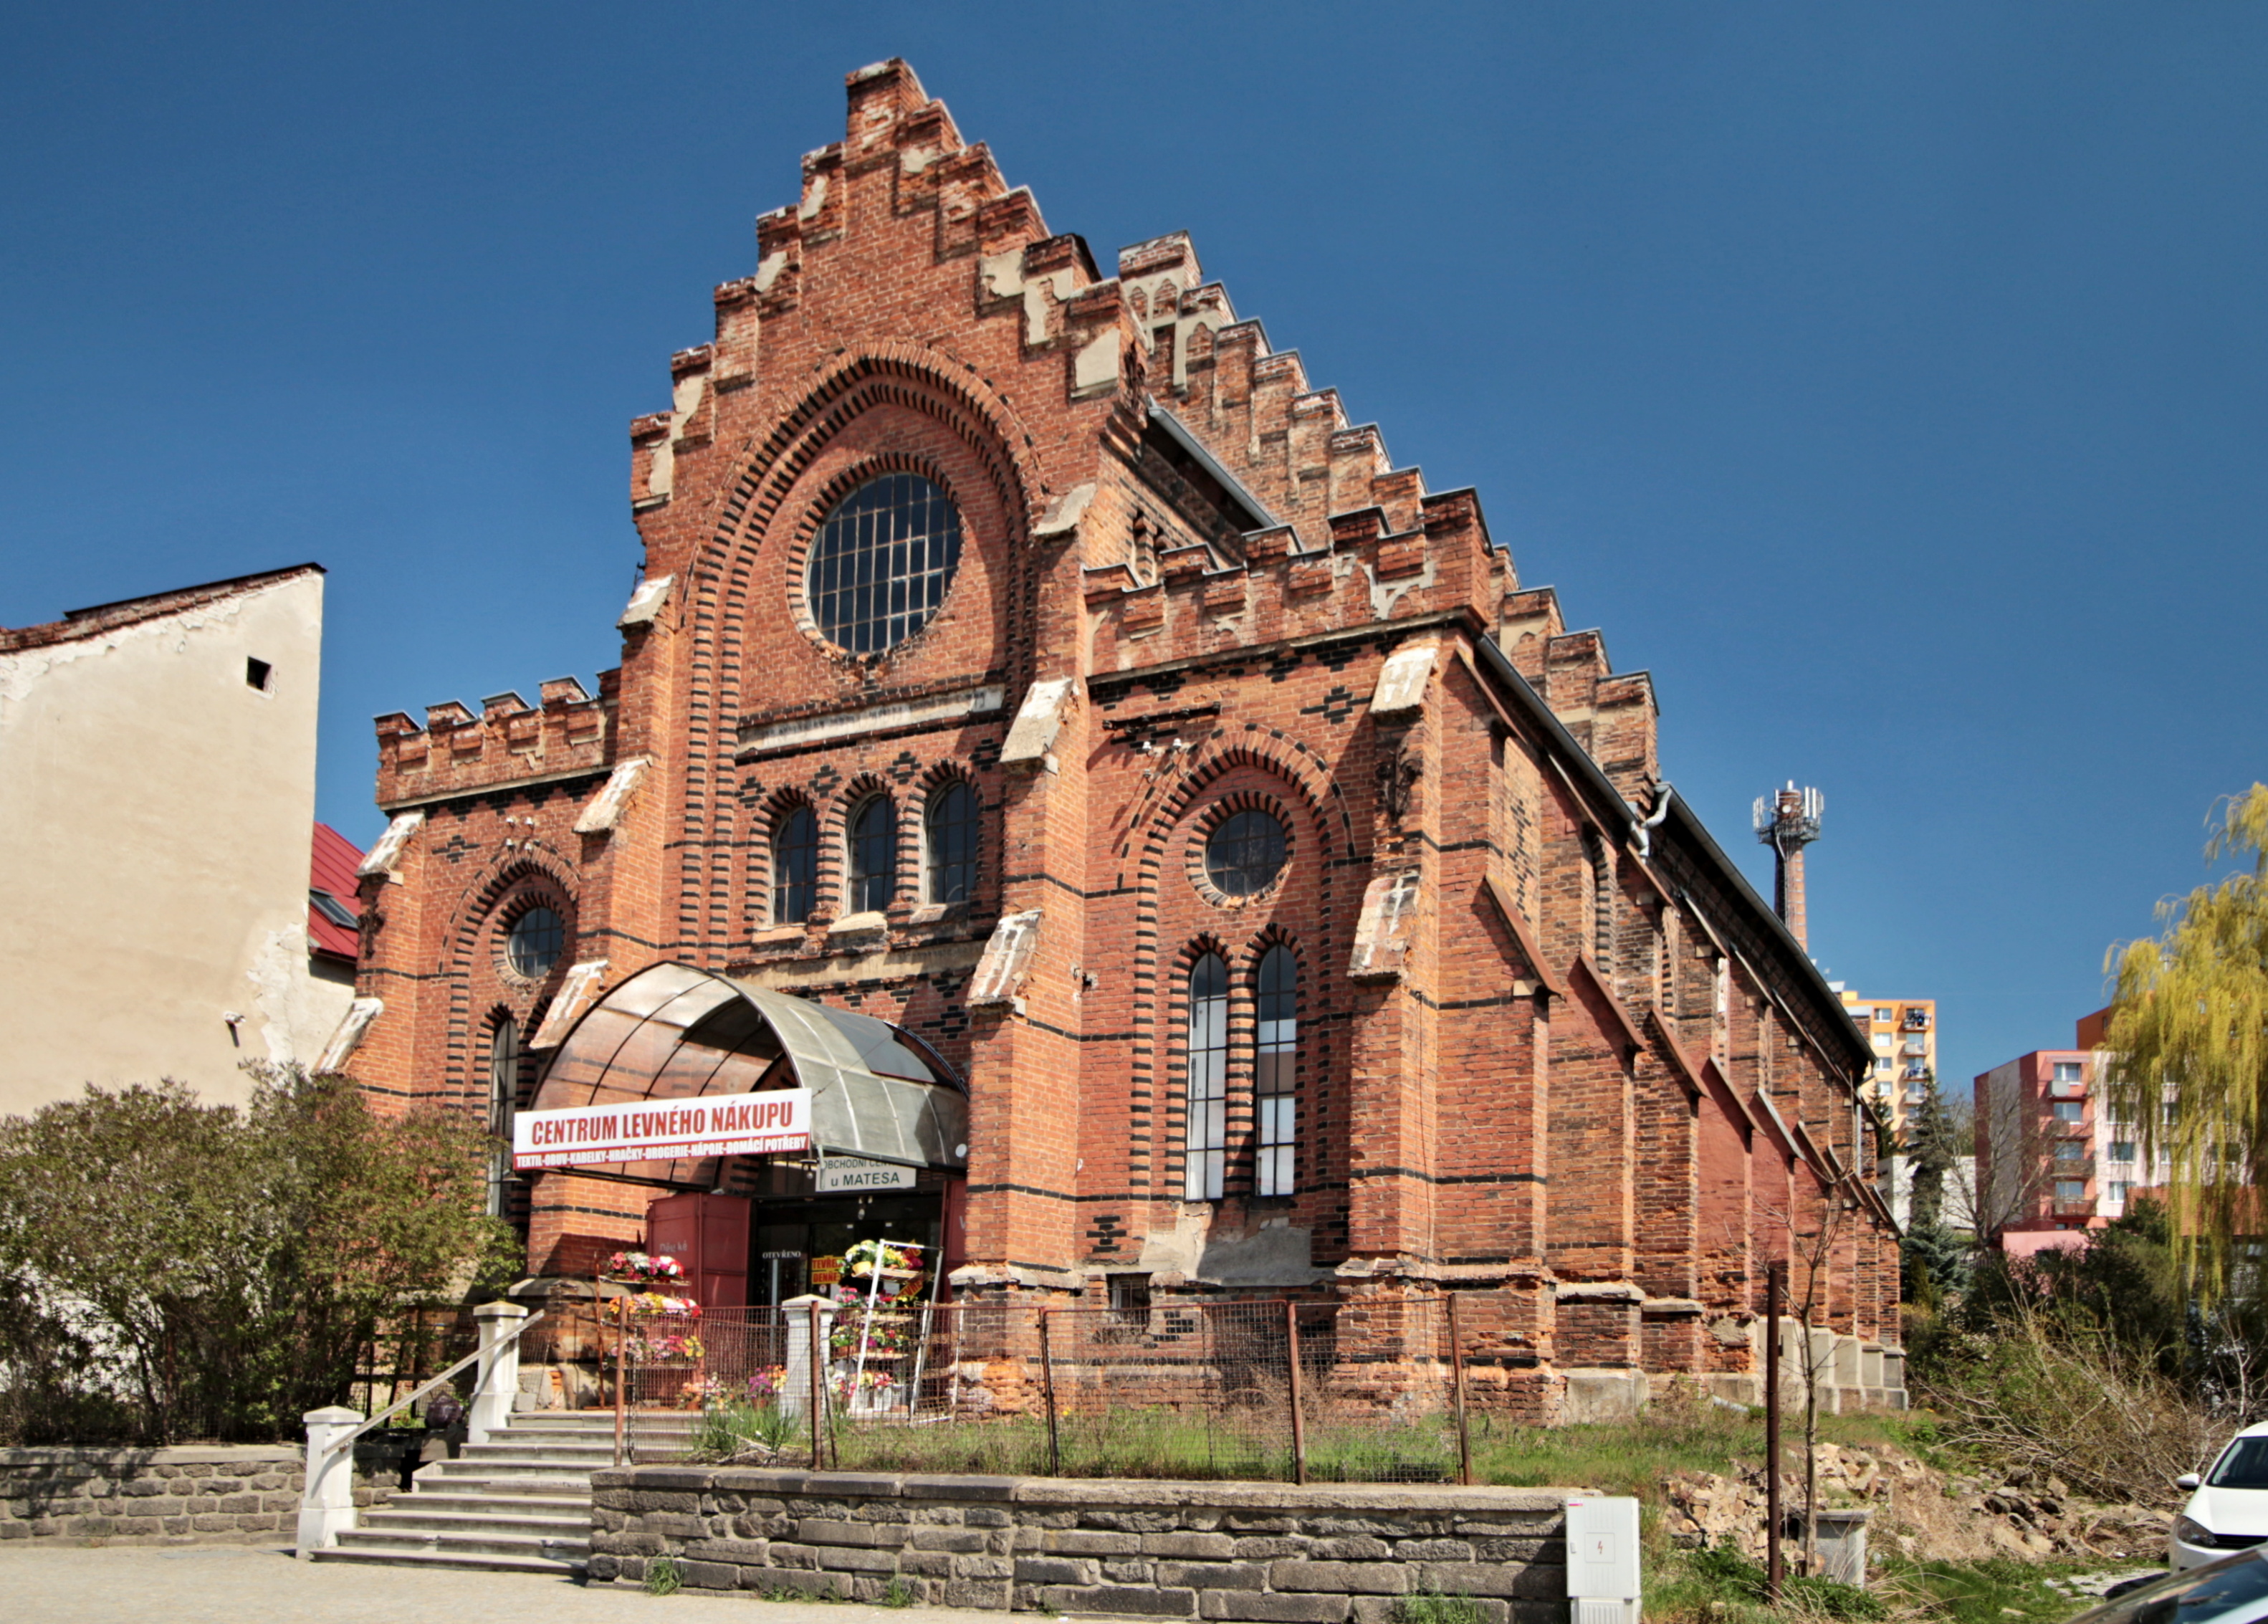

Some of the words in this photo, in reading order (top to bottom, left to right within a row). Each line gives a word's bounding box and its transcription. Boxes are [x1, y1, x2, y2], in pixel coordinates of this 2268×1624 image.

[532, 1115, 618, 1145] CENTRUM
[623, 1105, 706, 1138] LEVNÉHO
[711, 1100, 793, 1132] NÁKUPU
[765, 1135, 807, 1148] POTŘEBY
[843, 1172, 900, 1186] MATESA
[762, 1250, 801, 1259] OTEVŘENO
